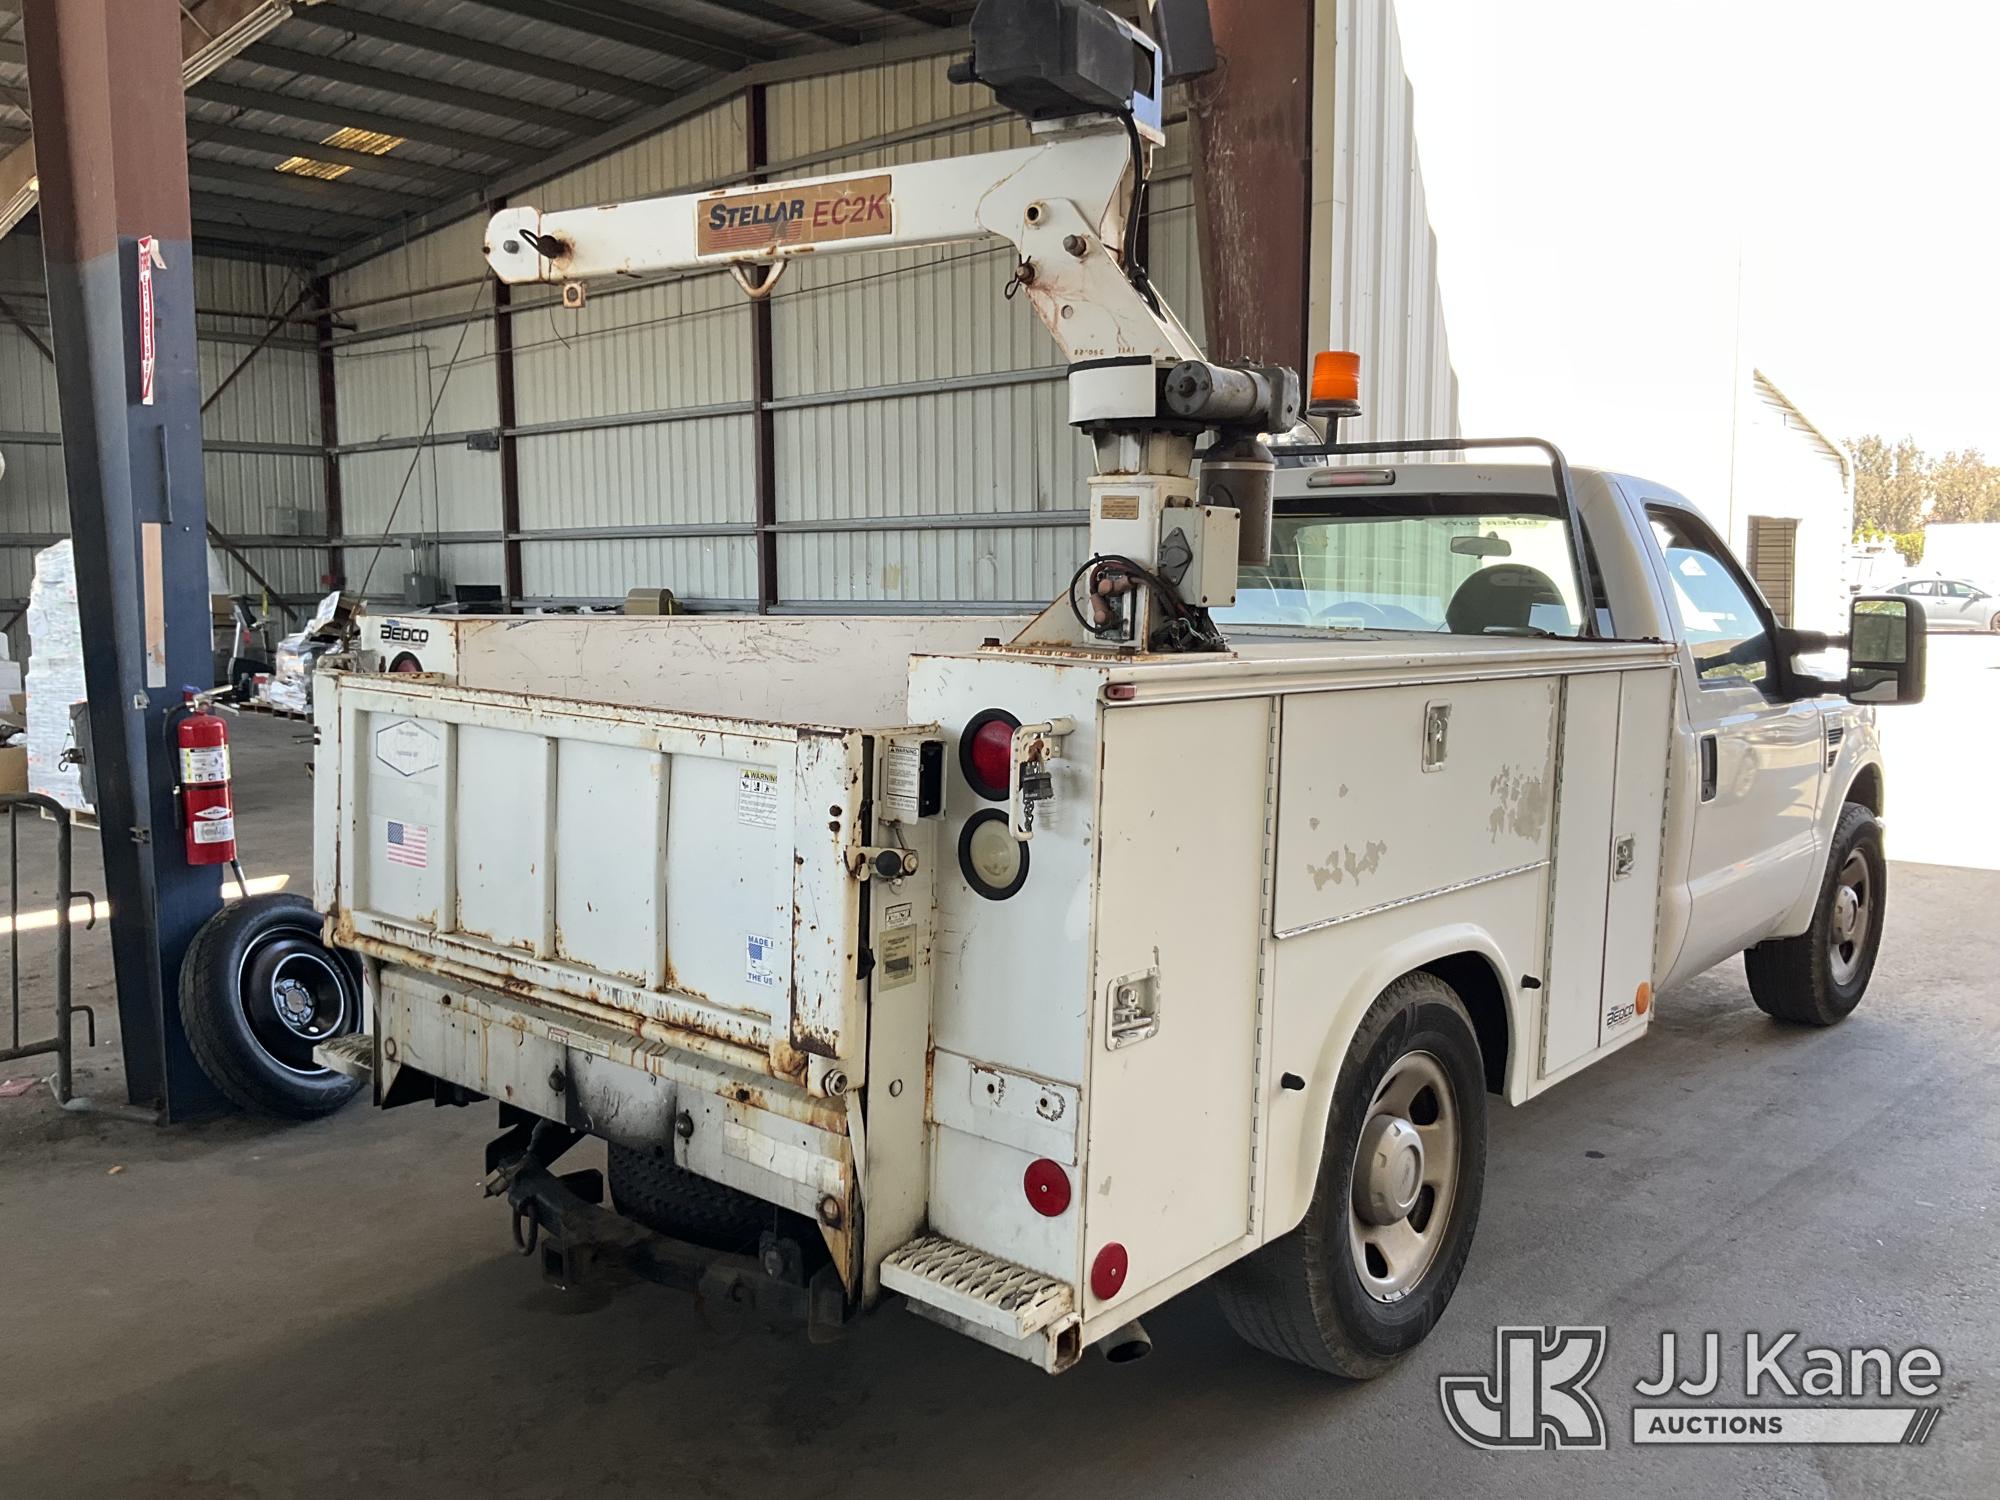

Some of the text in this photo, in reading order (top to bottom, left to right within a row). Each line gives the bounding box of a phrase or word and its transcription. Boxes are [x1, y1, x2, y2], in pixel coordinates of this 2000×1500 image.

[709, 192, 888, 230] STELLAR EC2K
[380, 624, 429, 643] BEDCO
[748, 935, 768, 947] MADE
[748, 972, 761, 982] THE
[1606, 1003, 1634, 1026] BEDCO
